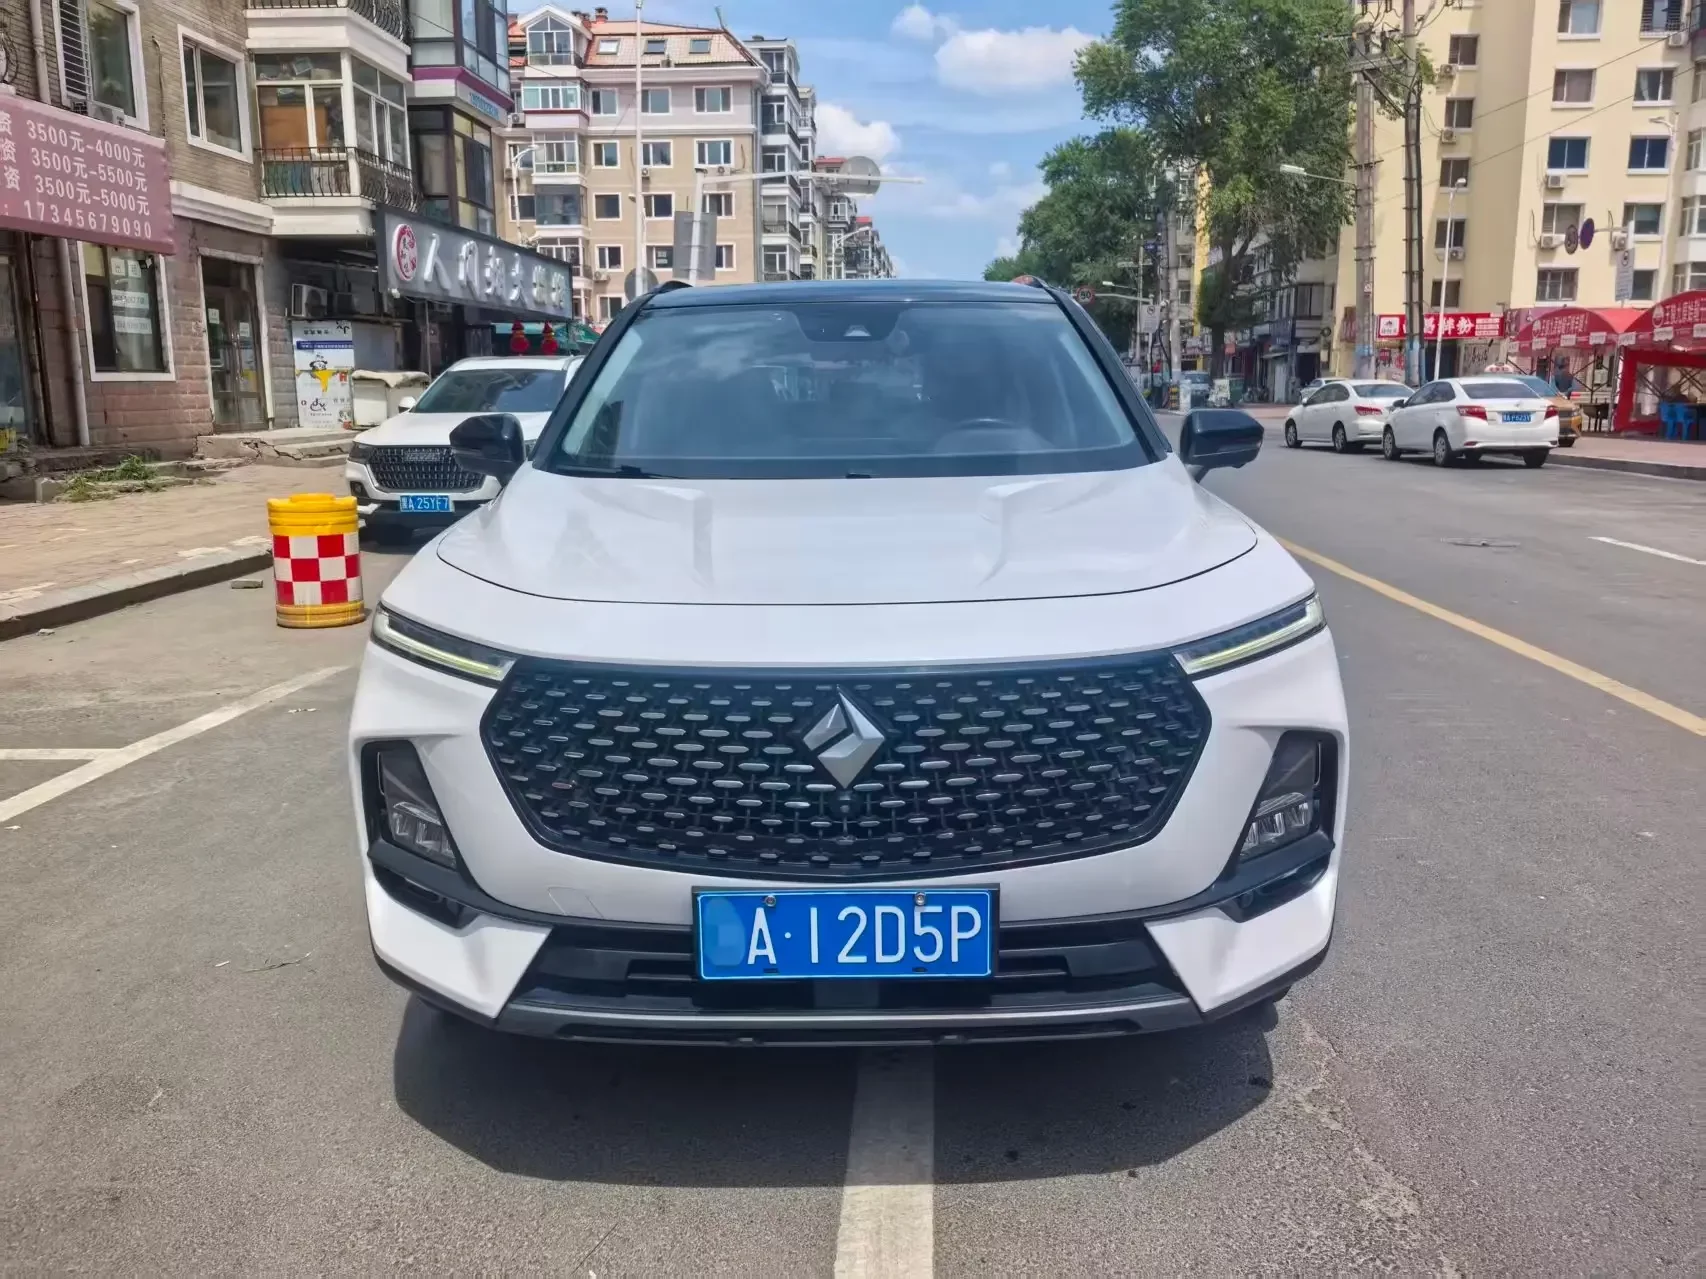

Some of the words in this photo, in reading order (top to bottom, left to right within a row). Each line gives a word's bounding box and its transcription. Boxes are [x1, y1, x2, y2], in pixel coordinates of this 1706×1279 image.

[26, 119, 145, 168] 3500元-4000元
[3, 165, 20, 192] 资
[34, 174, 150, 217] 3500元-5000元
[31, 147, 148, 193] 3500元-5500元
[23, 200, 152, 239] 17345679090
[705, 904, 982, 965] A·12D5P
